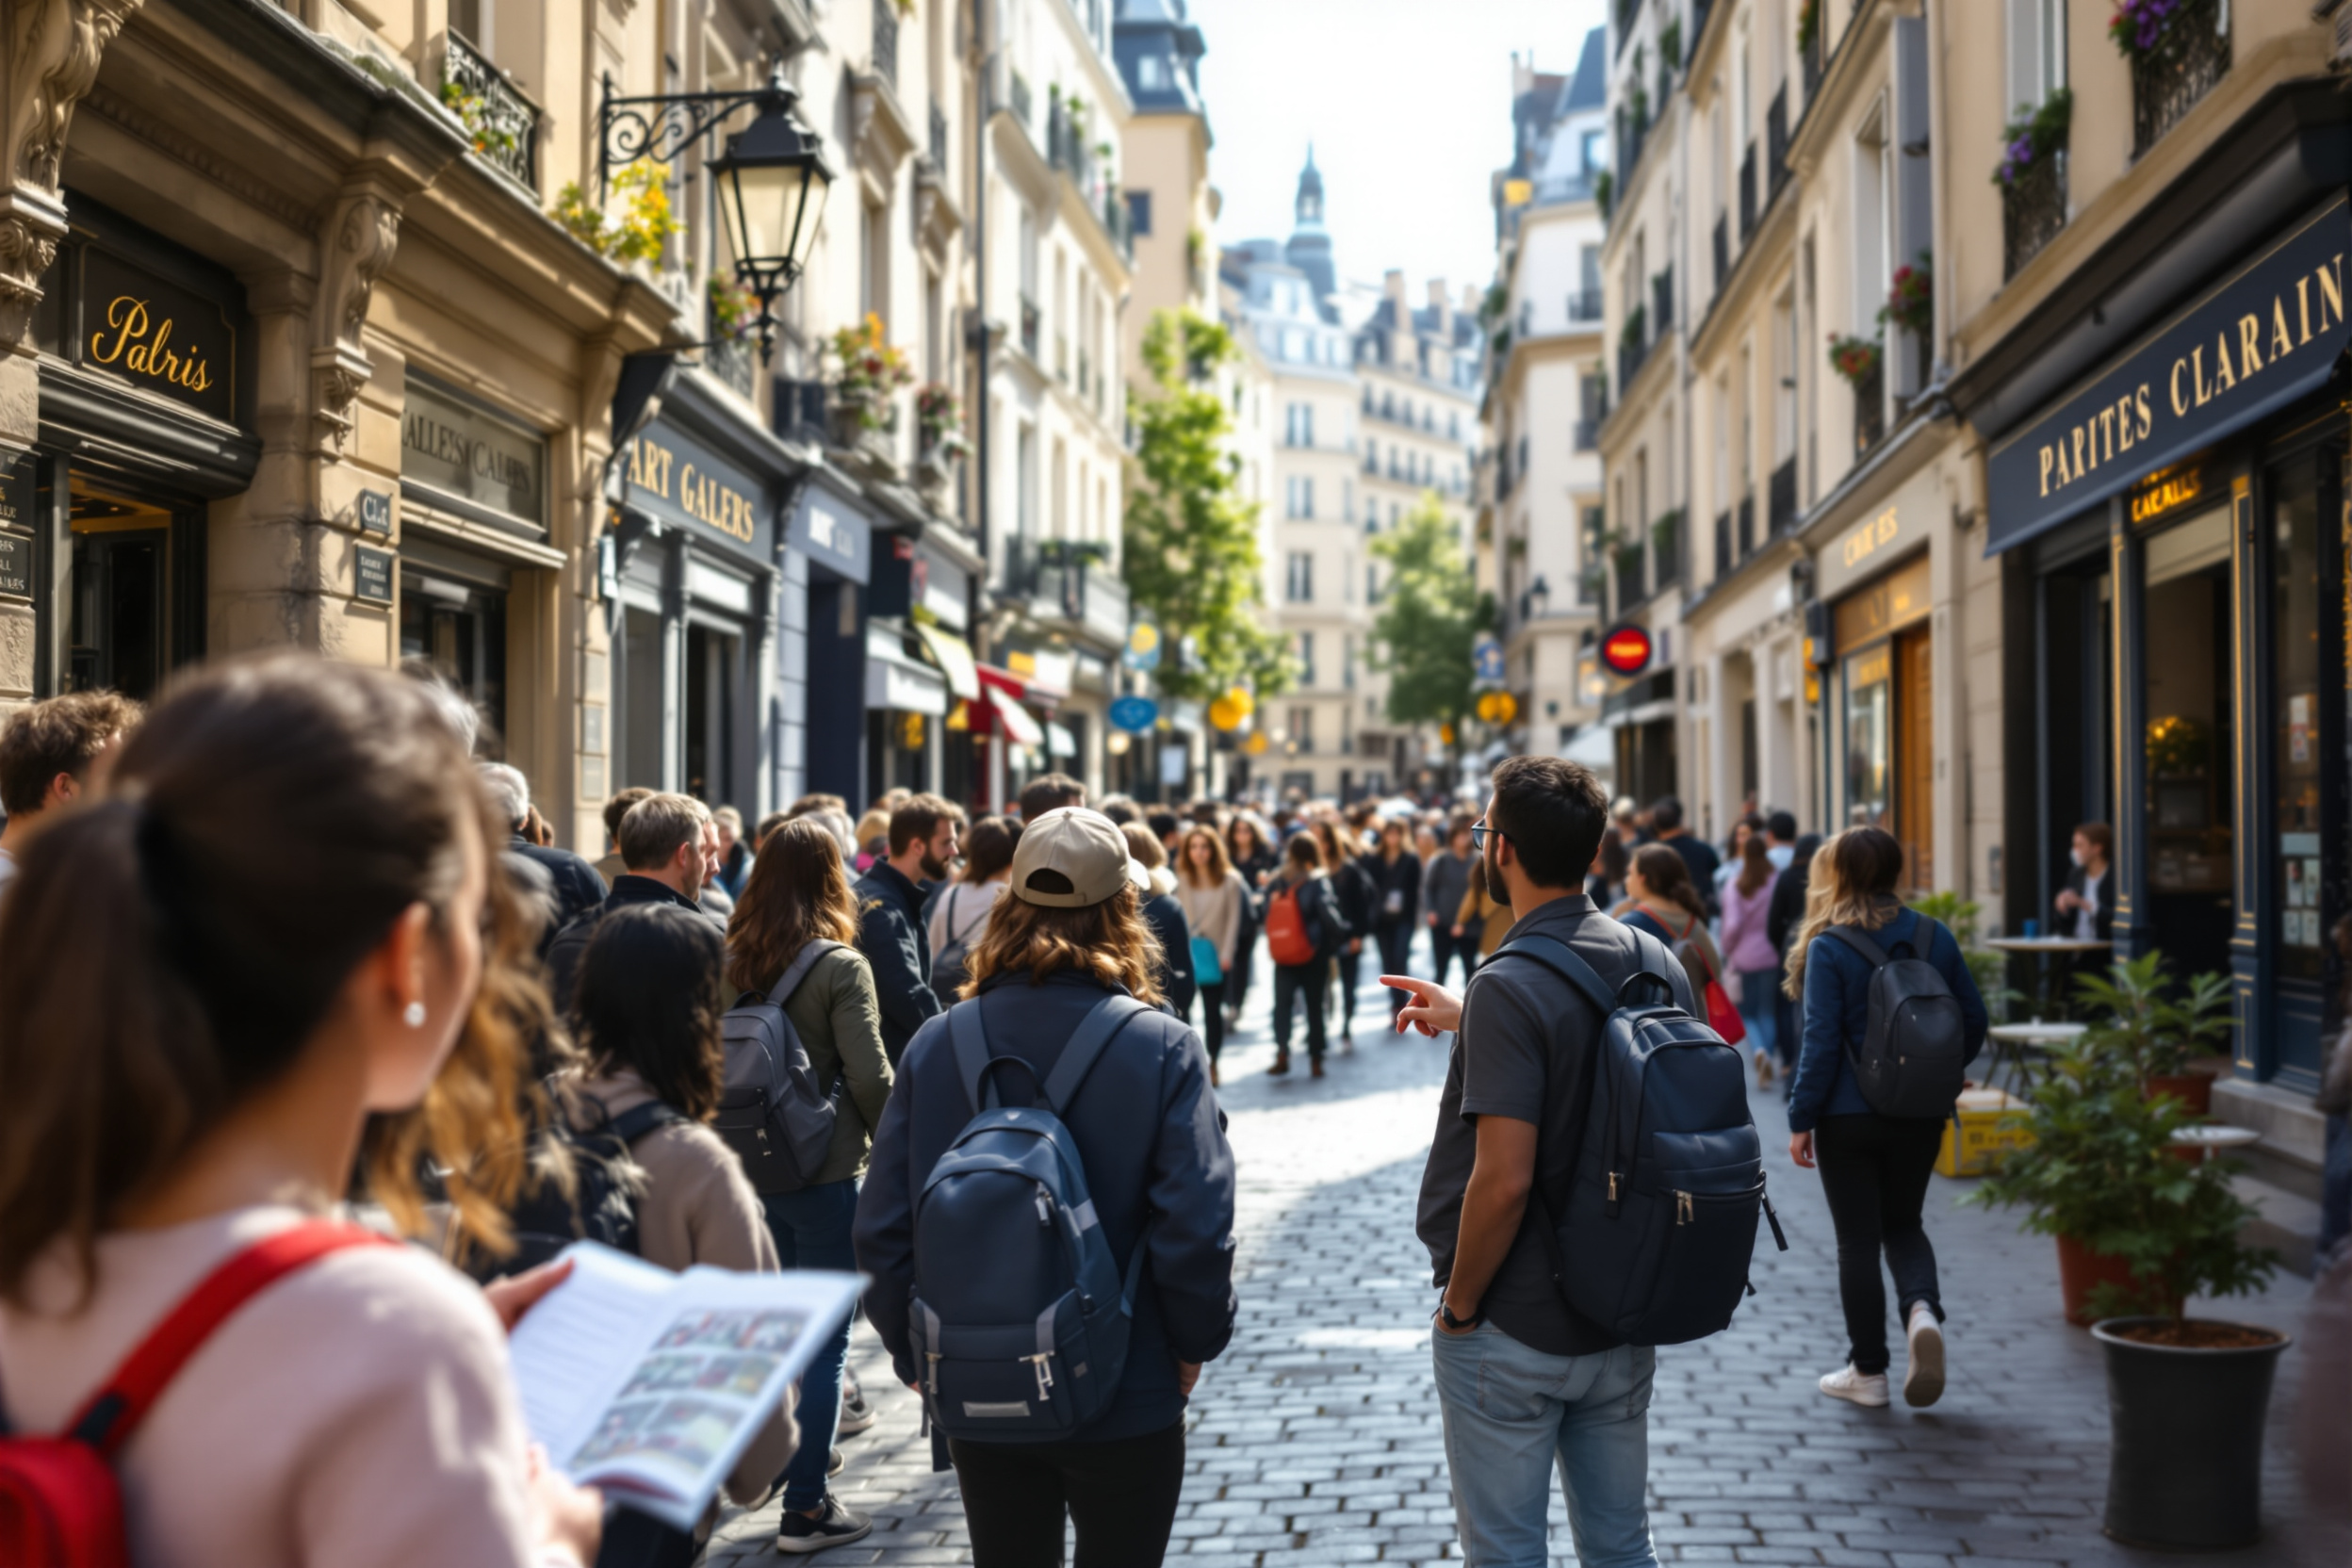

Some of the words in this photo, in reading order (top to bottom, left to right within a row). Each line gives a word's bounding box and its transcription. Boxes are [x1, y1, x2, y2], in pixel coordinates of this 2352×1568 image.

[2038, 382, 2152, 498] PARITES
[2169, 253, 2344, 417] CLARAIN
[626, 434, 674, 499] ART
[679, 463, 754, 544] GALERS
